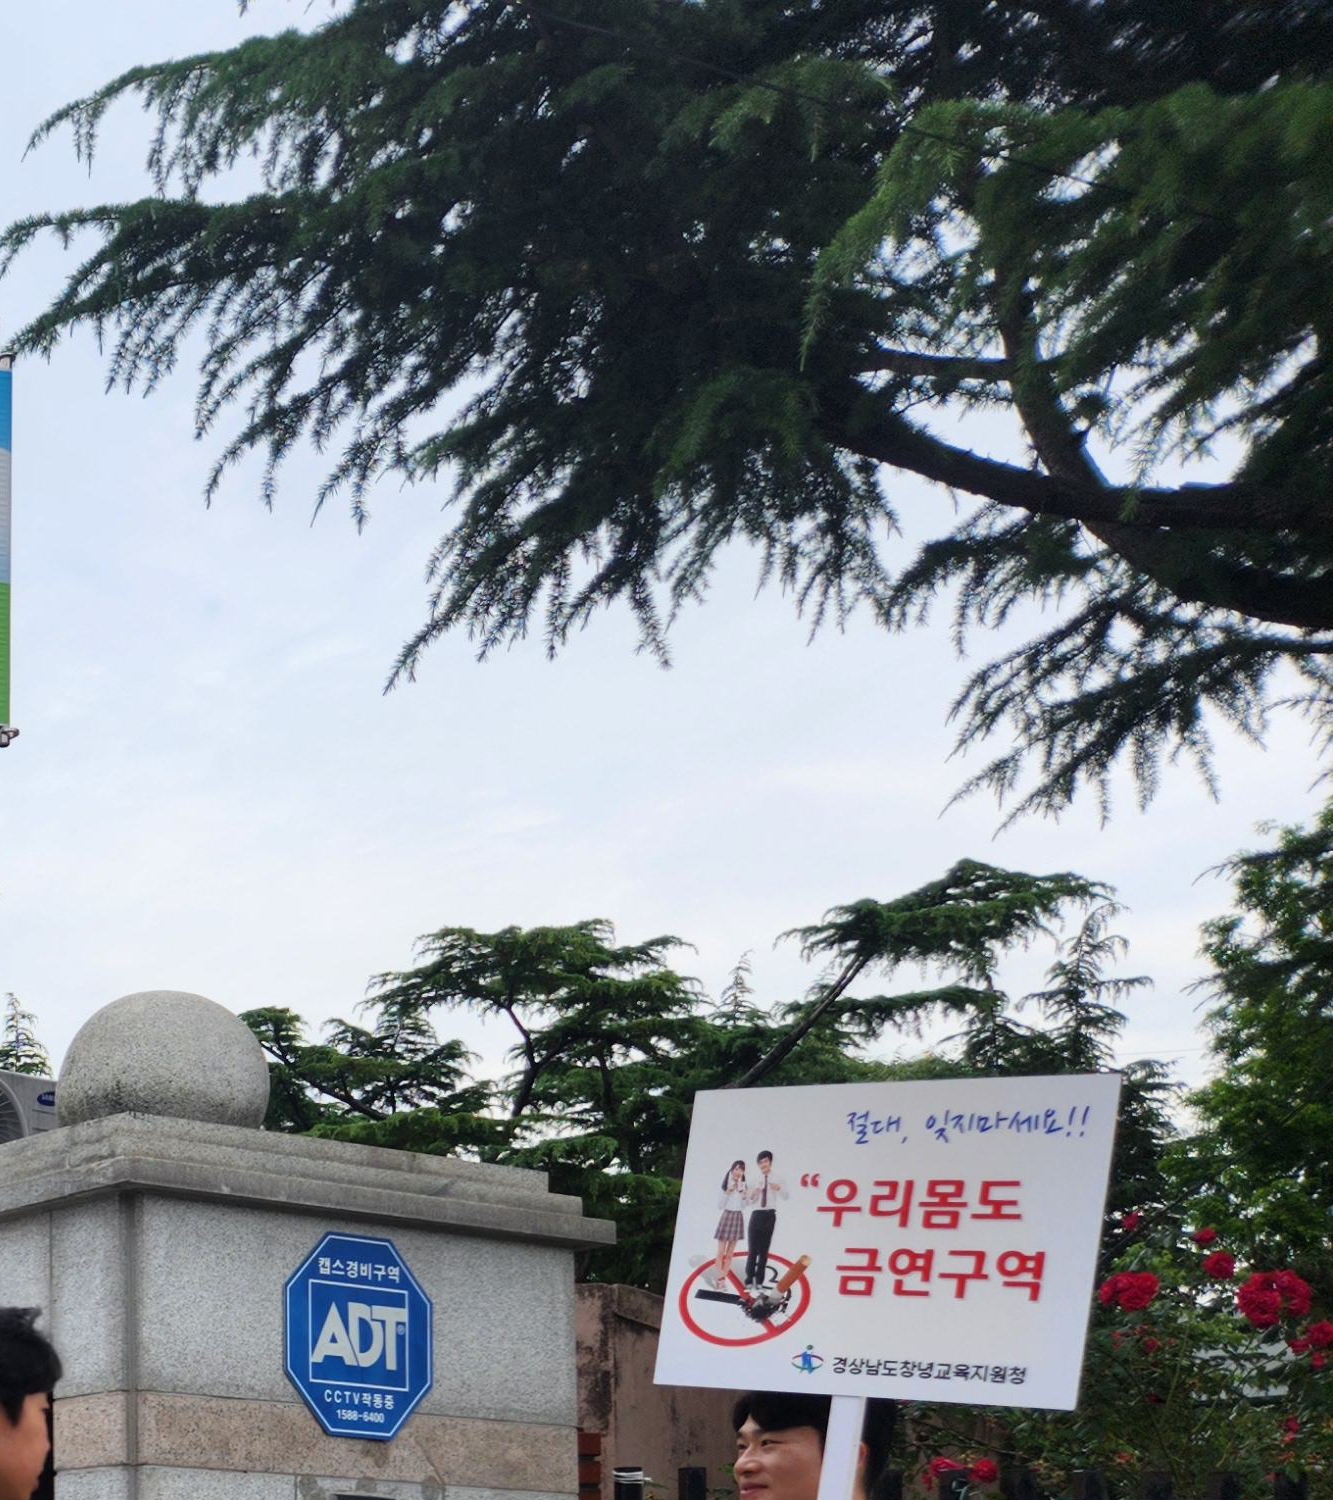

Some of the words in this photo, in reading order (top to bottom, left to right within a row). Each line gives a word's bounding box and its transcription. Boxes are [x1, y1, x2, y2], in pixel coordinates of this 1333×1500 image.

[845, 1110, 909, 1145] 절대,
[924, 1104, 1092, 1145] 잊지마세요!!
[317, 1256, 401, 1285] 캡스경비구역
[835, 1246, 1047, 1304] 금연구역
[310, 1300, 408, 1372] ADT
[831, 1355, 1028, 1386] 경상남도창녕교육지원청
[336, 1409, 385, 1424] 1588-6400
